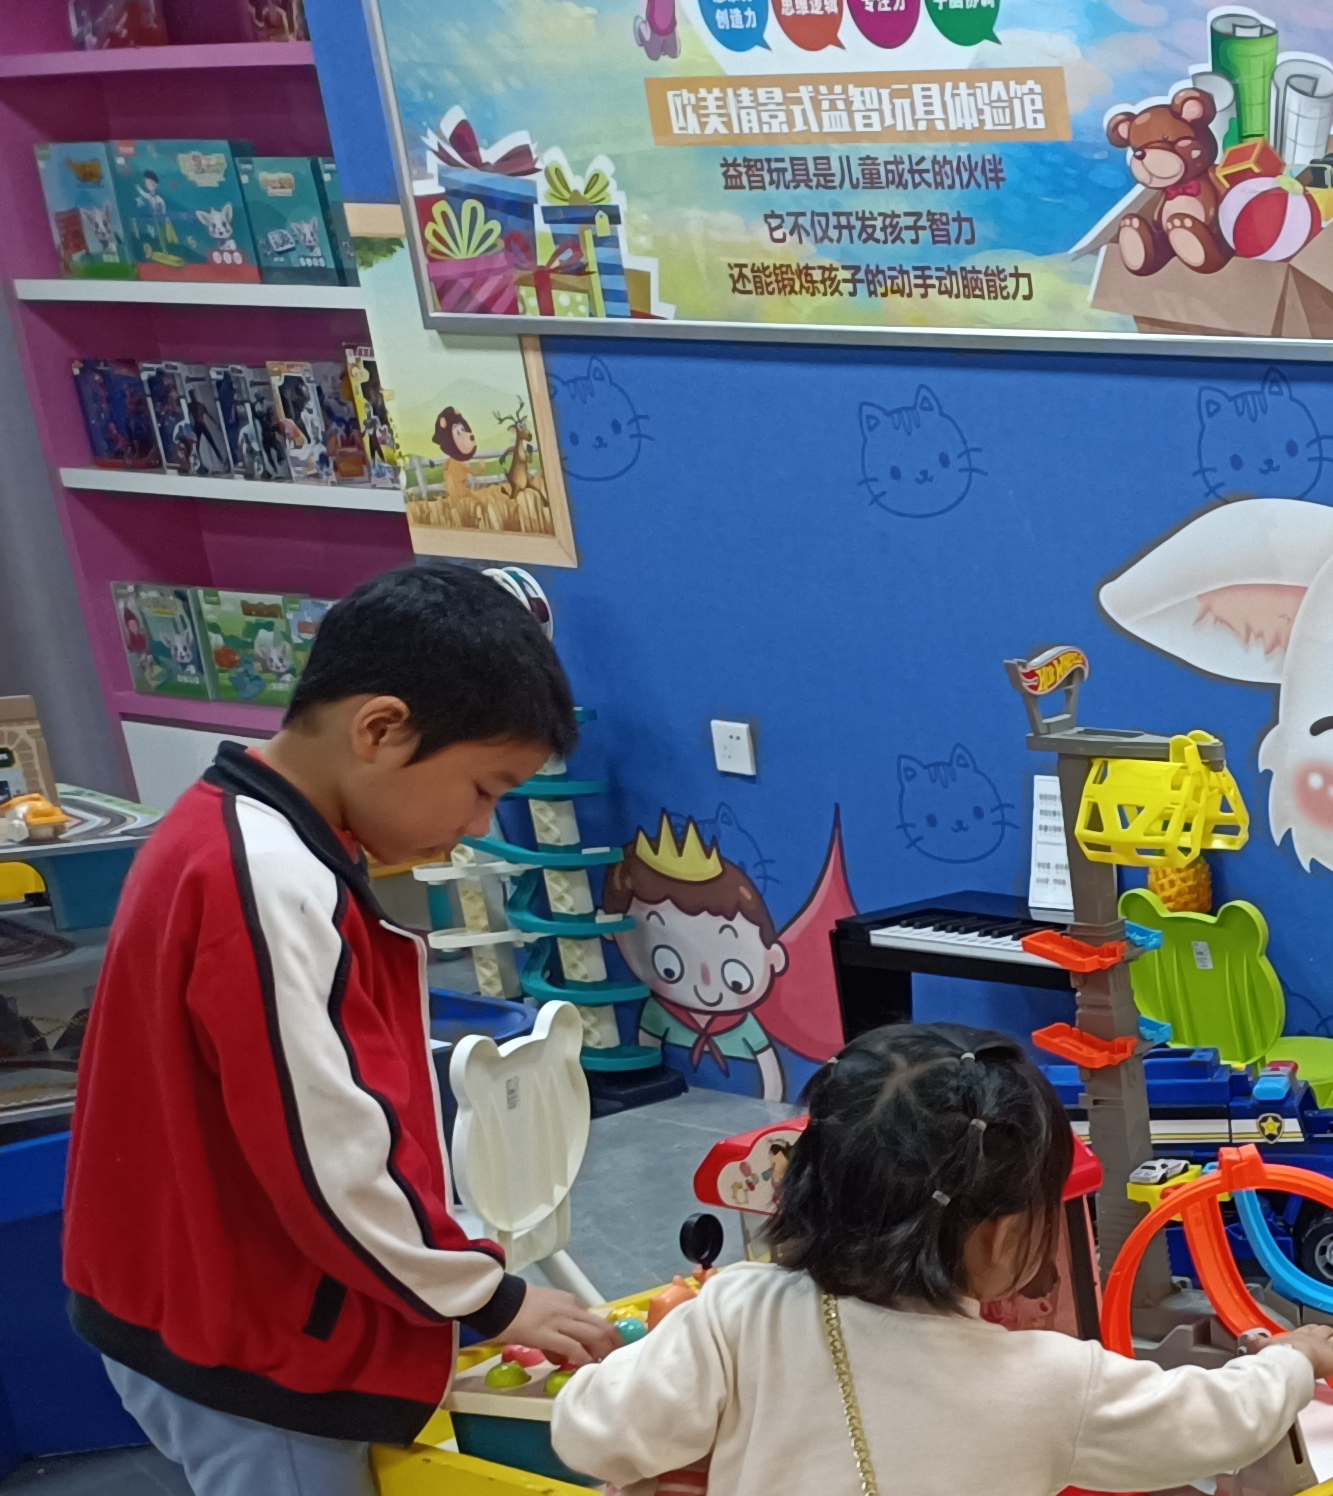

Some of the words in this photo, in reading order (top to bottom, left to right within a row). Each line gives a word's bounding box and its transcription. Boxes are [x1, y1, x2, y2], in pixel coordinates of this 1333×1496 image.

[715, 7, 757, 30] 创造力
[667, 80, 1045, 135] 欧美情景式益智玩具体验馆
[720, 154, 1007, 194] 益智玩具是儿童成长的伙伴
[762, 209, 977, 247] 它不仅开发孩子智力
[726, 261, 1034, 302] 还能锻炼孩子的动手动脑能力
